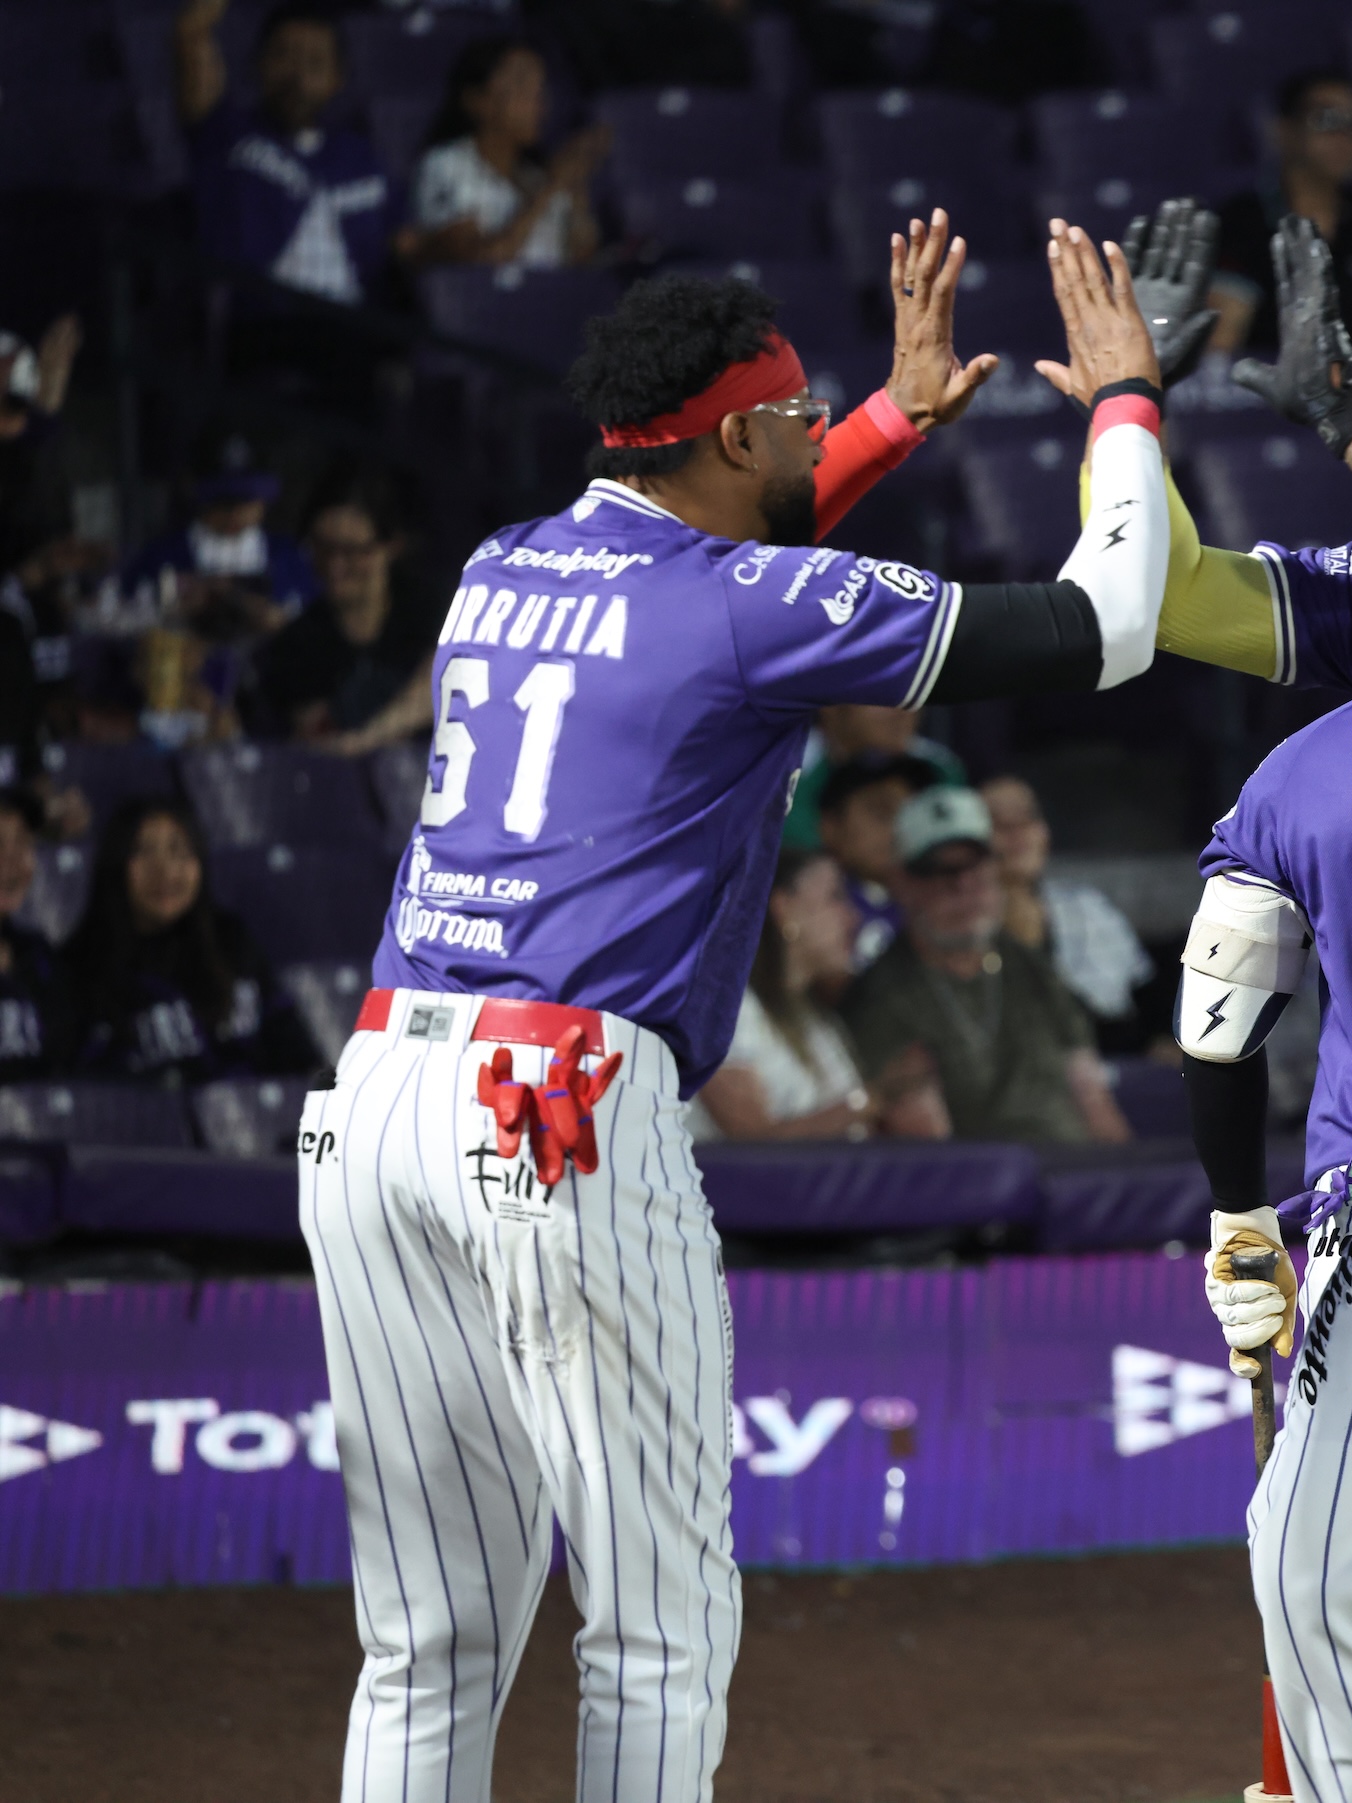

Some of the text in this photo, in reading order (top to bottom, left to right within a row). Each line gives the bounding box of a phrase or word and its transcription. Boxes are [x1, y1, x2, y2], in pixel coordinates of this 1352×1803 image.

[502, 546, 641, 580] Totalplay
[834, 568, 868, 608] GAS
[421, 871, 539, 901] FIRMA CAR
[395, 895, 505, 955] Corona
